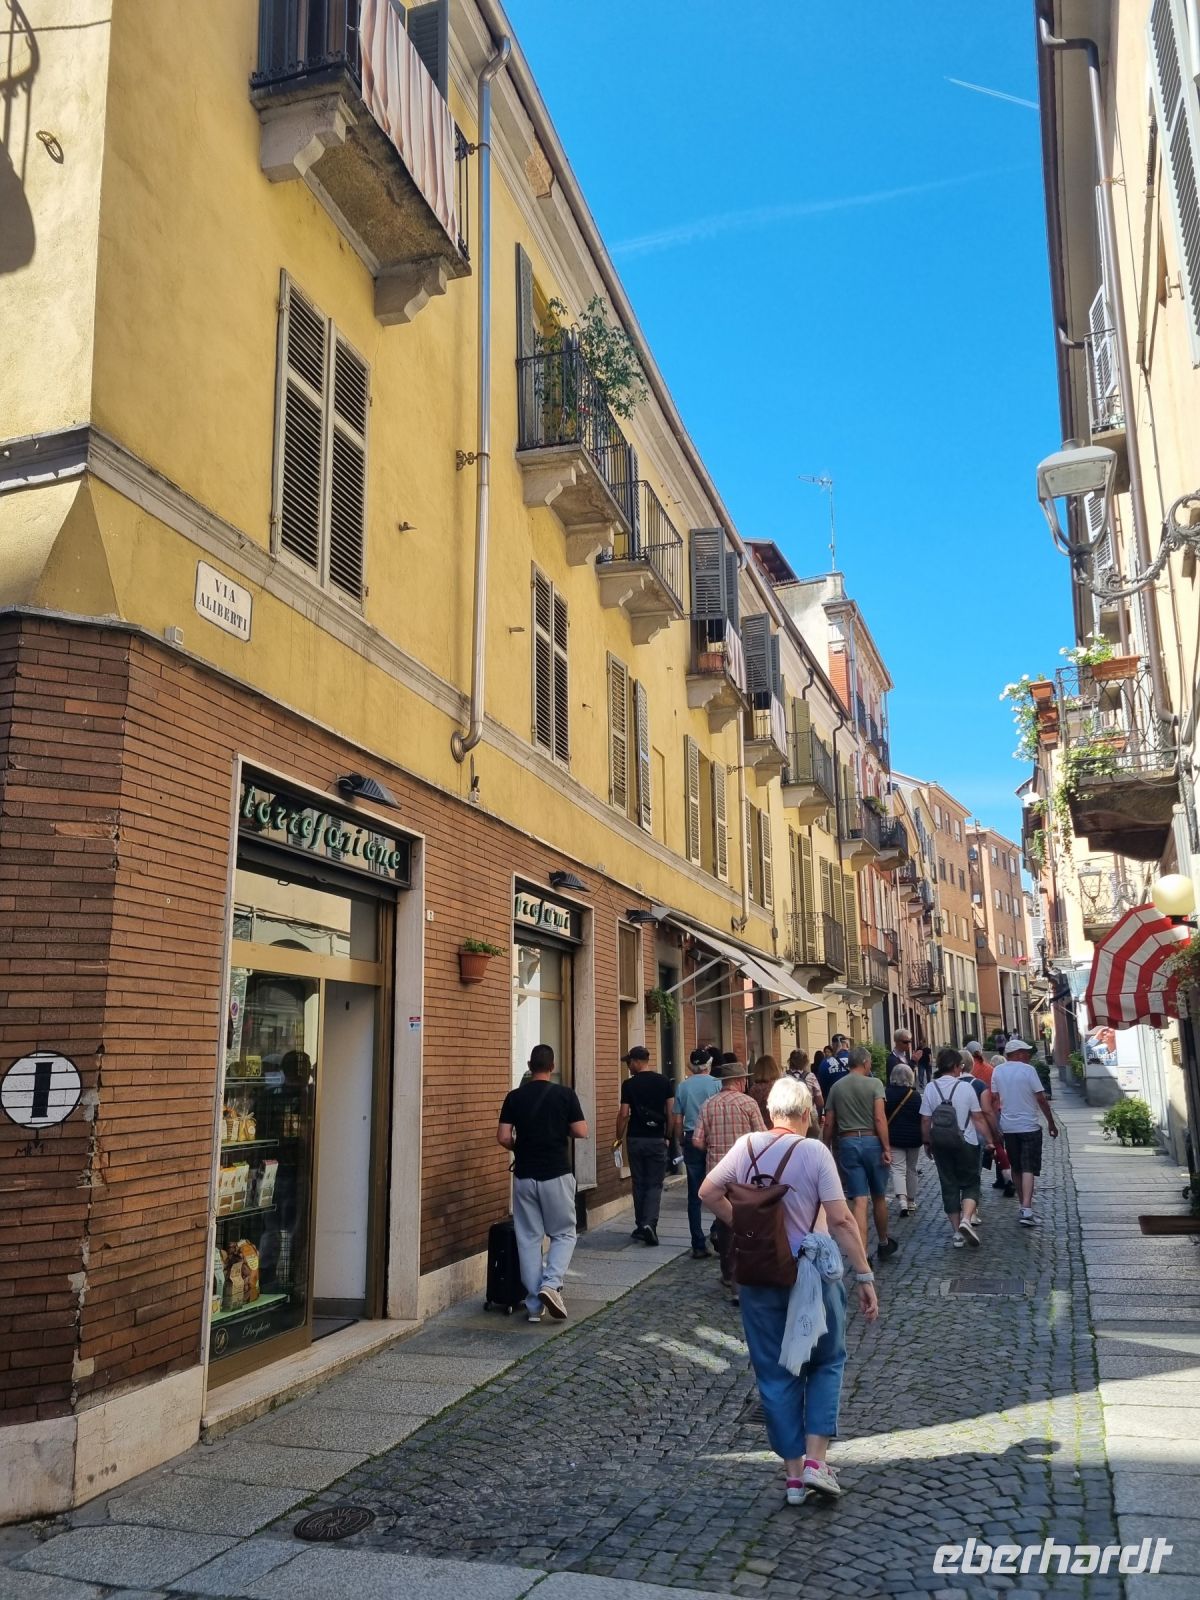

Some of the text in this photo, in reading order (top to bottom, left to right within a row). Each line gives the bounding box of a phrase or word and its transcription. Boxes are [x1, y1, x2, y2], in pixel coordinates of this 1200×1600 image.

[215, 578, 235, 603] VIA
[199, 592, 247, 632] ALIBERTI
[242, 785, 400, 869] torrefazione
